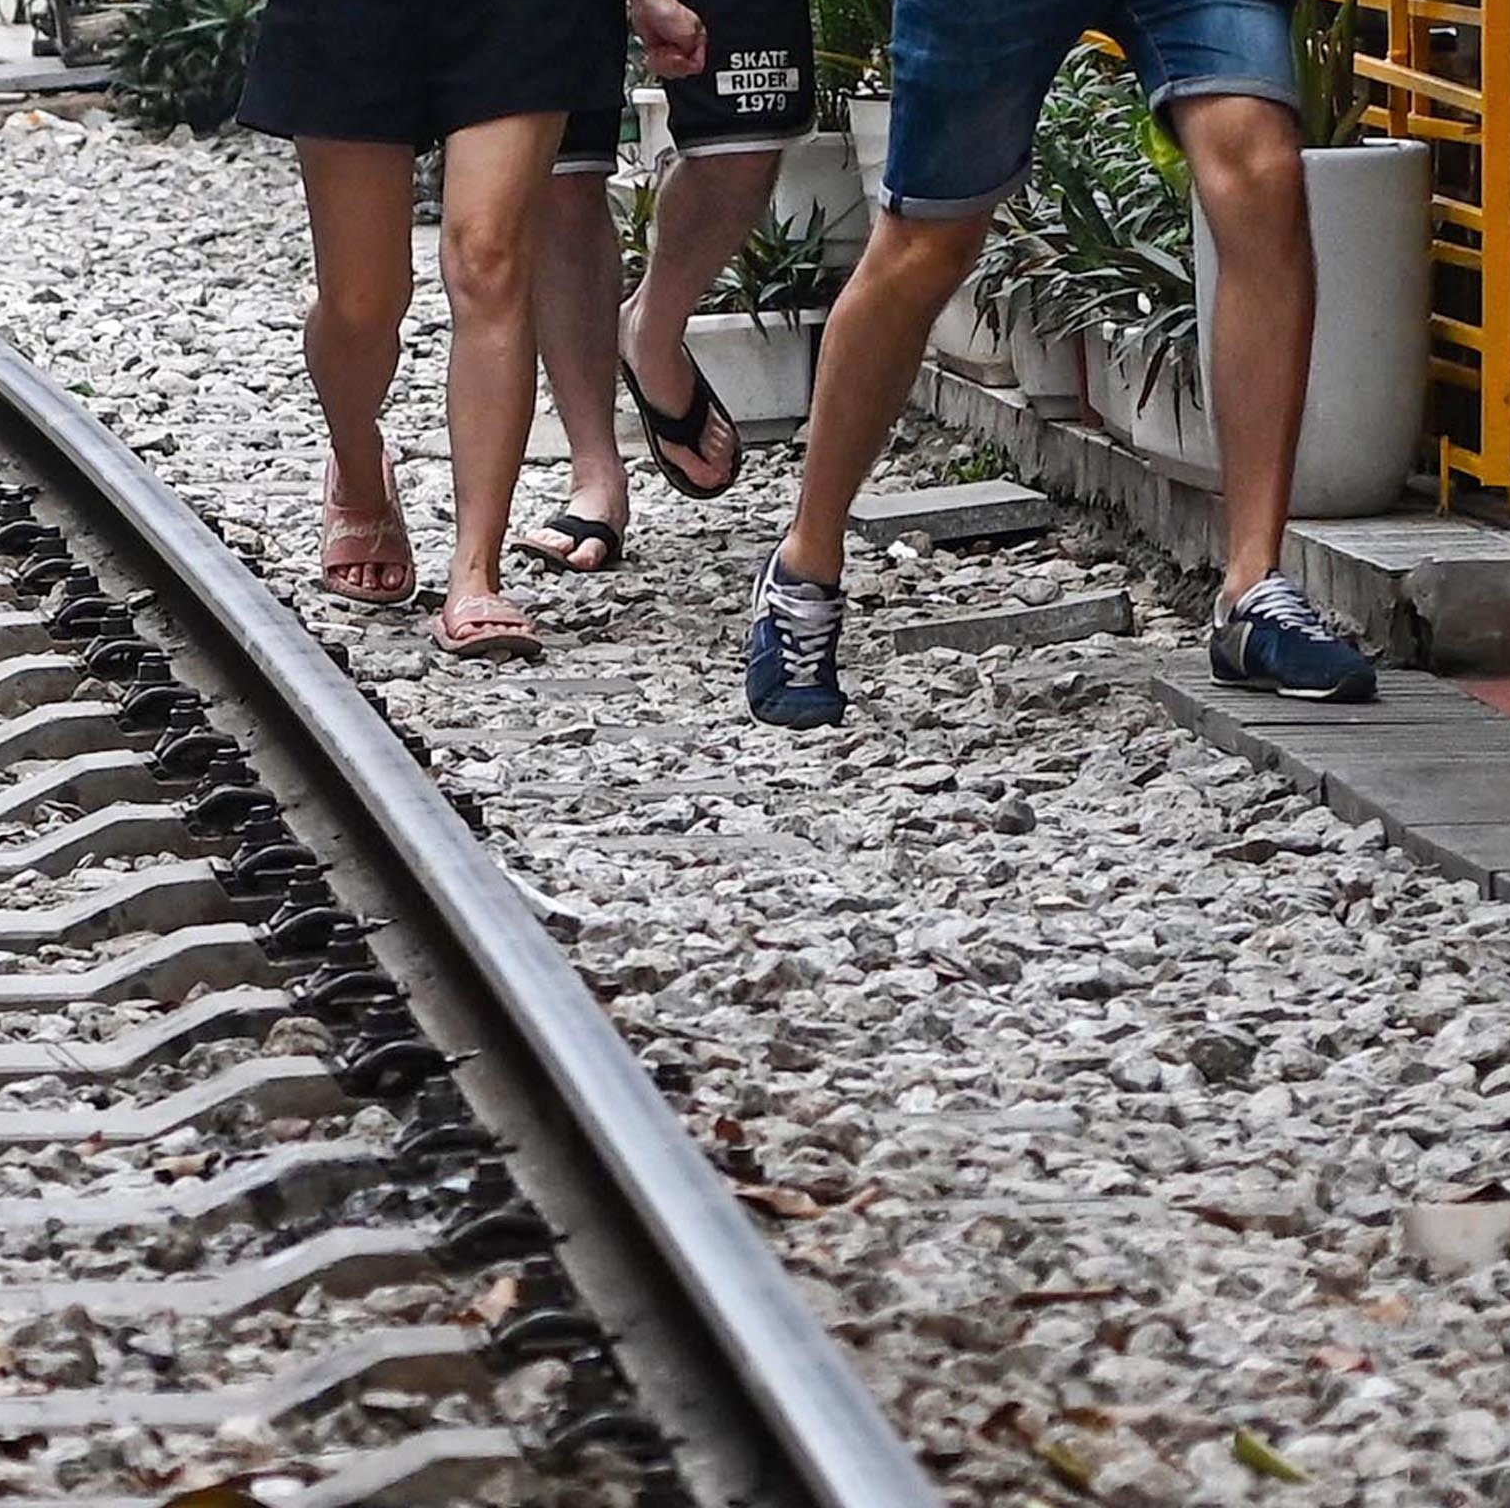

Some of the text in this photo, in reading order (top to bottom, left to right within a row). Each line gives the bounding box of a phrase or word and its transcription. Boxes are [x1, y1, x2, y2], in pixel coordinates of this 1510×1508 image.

[730, 50, 789, 69] SKATE
[731, 72, 788, 91] RIDER
[736, 93, 787, 113] 1979
